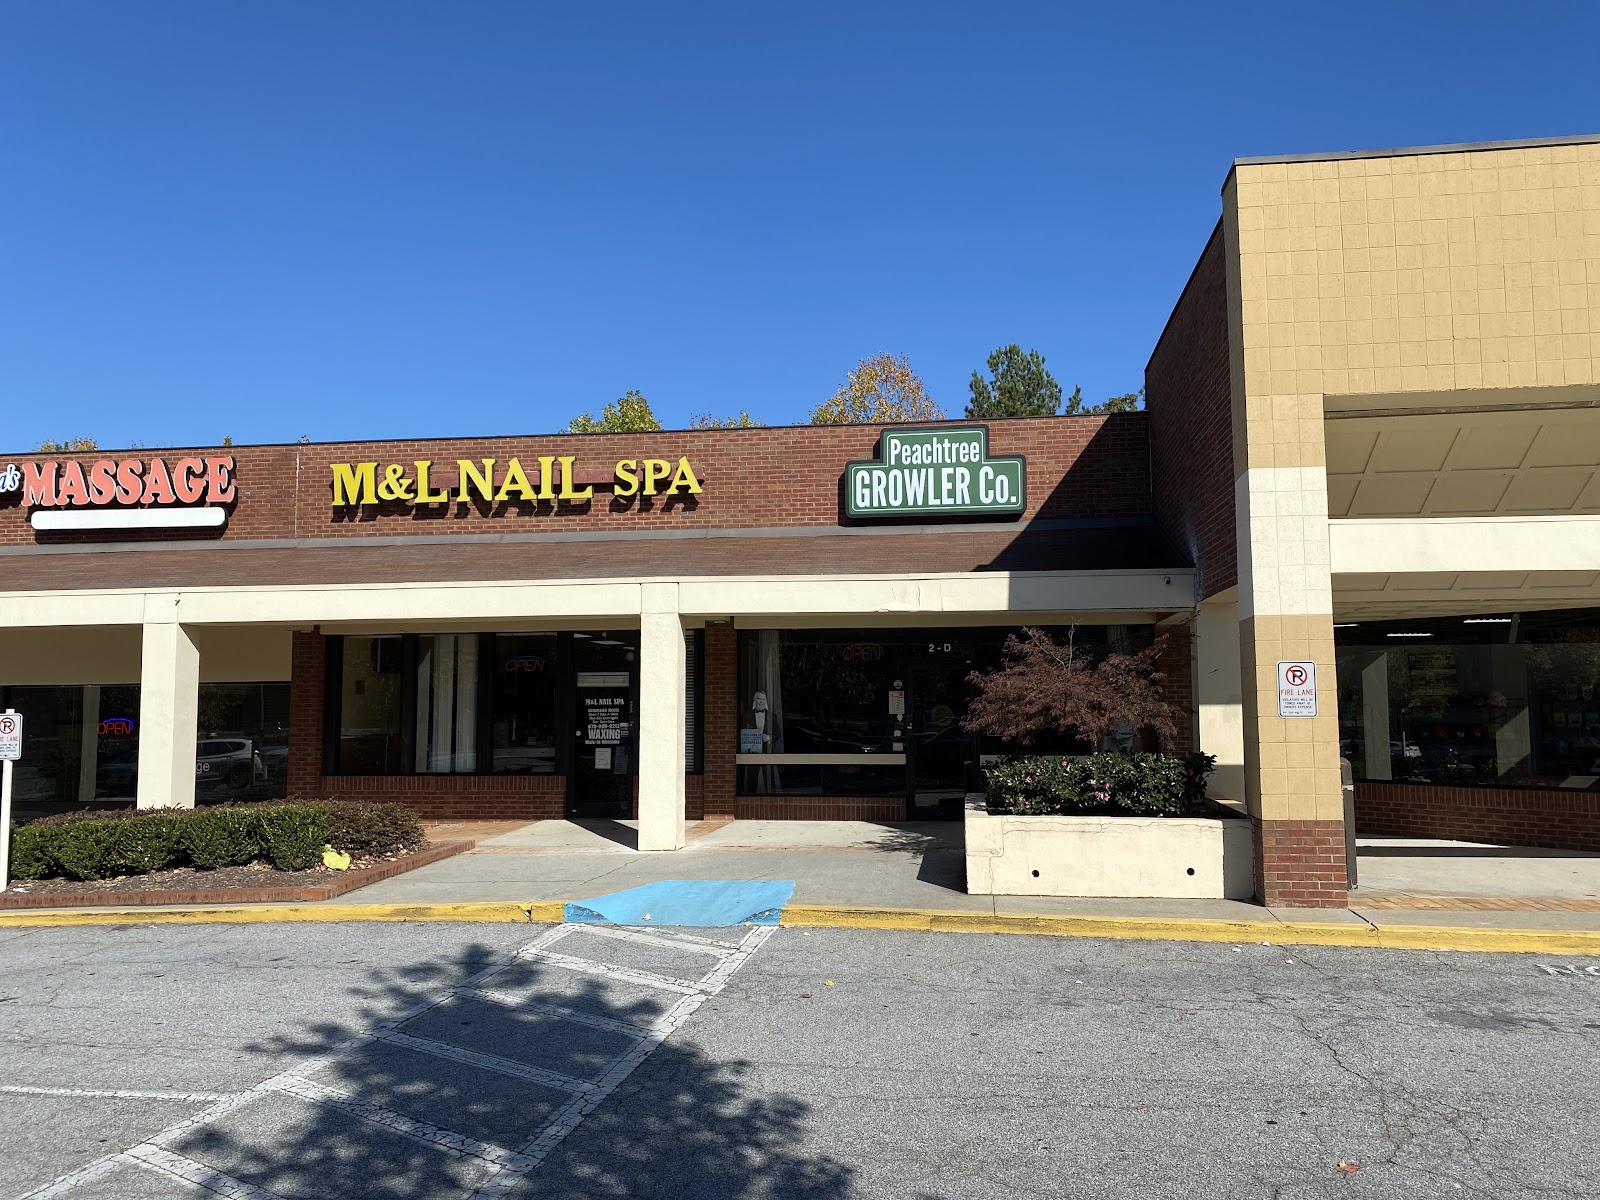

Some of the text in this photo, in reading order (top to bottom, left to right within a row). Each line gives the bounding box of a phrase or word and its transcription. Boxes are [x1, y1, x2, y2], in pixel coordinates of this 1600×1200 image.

[890, 437, 980, 465] Peachtree
[21, 456, 236, 507] MASSAGE
[330, 455, 703, 507] M&L NAIL SPA
[855, 465, 1017, 508] GROWLER Co.
[842, 647, 881, 660] OPEN
[505, 659, 546, 672] OPEN
[585, 698, 599, 706] M&L
[599, 698, 613, 706] NAIL
[97, 722, 131, 735] OPEN
[587, 729, 621, 739] WAXING
